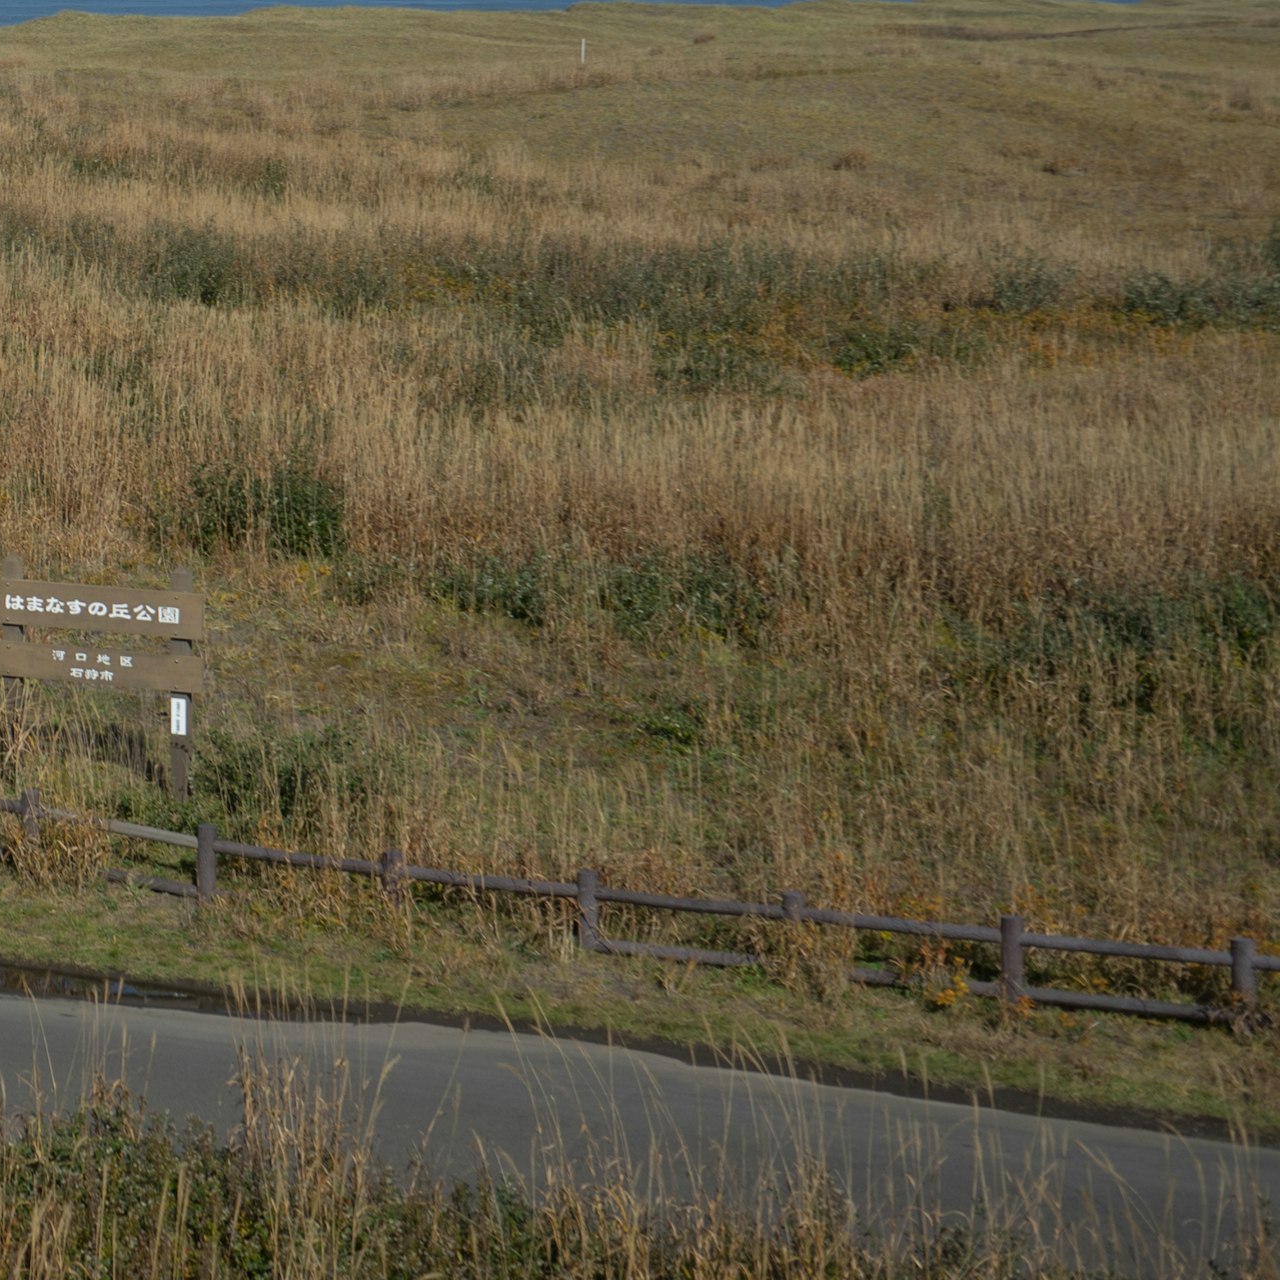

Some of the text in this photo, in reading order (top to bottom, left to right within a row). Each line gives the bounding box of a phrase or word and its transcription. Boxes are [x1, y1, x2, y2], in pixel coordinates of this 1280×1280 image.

[5, 594, 180, 624] はまなすの丘公園
[52, 650, 133, 667] 河口地区
[70, 668, 114, 681] 石狩市
